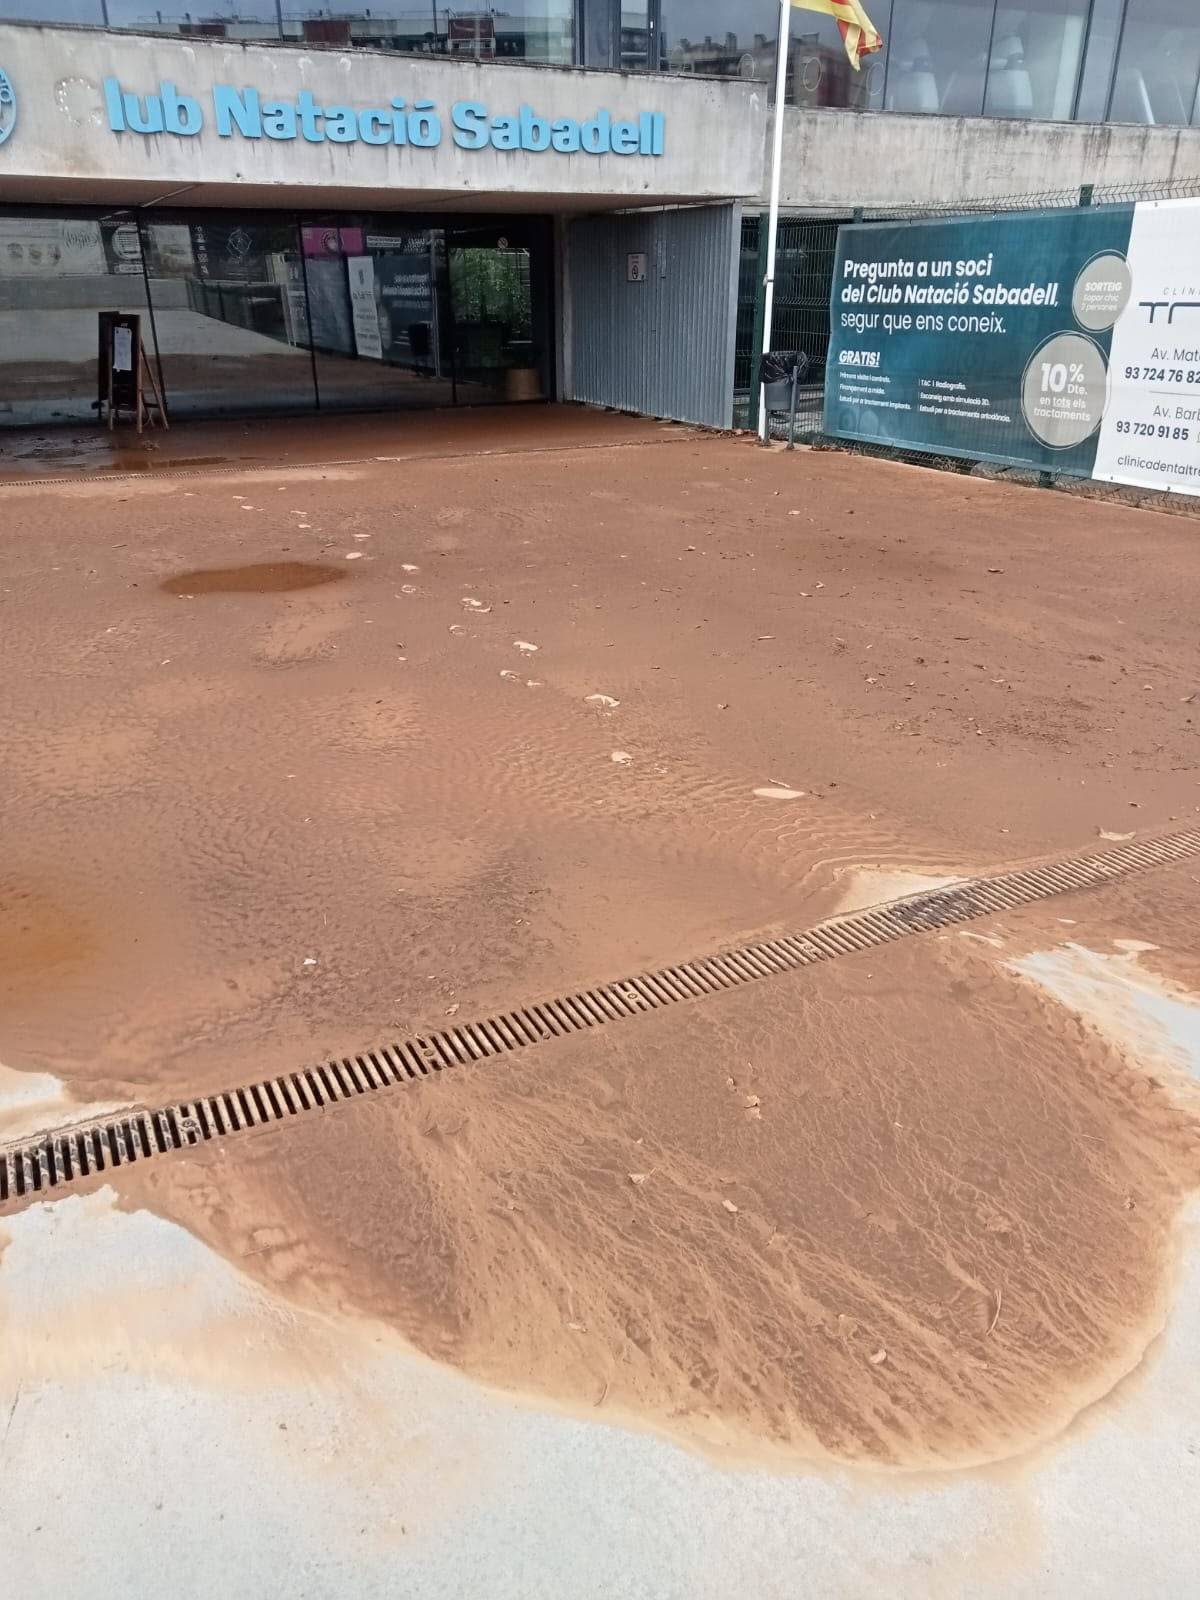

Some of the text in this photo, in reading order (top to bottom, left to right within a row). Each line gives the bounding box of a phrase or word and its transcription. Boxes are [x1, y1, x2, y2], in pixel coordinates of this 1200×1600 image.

[212, 84, 441, 148] Natació
[452, 102, 665, 156] Sabadell
[844, 253, 993, 283] Pregunta a un soci
[1085, 281, 1122, 292] SORTEIG
[841, 282, 1059, 307] del Club Natació Sabadell,
[841, 311, 1007, 335] segur que ens coneix.
[838, 350, 880, 366] GRATIS!
[1151, 348, 1168, 360] Av.
[1125, 366, 1200, 384] 93 724 76 82
[920, 379, 931, 387] TAC
[1067, 384, 1088, 395] Dte.
[1040, 397, 1086, 408] en tots els
[1033, 407, 1091, 421] tractaments
[1153, 405, 1171, 418] Av.
[1116, 421, 1189, 440] 93 720 91 85
